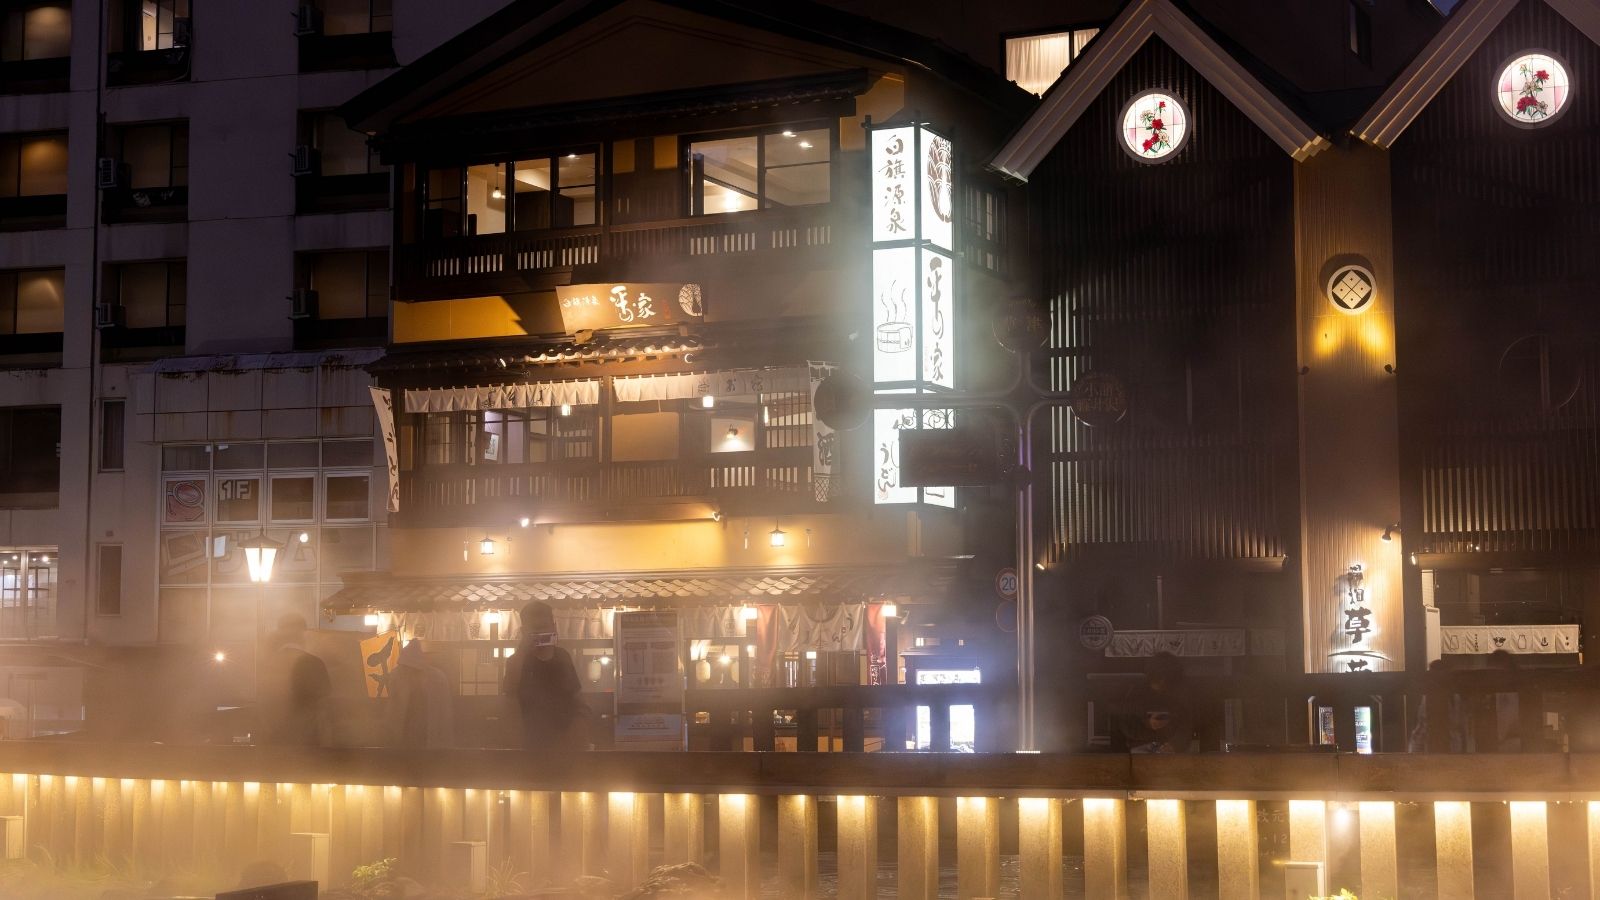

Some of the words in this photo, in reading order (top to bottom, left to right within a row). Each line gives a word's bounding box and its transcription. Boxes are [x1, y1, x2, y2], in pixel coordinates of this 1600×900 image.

[878, 134, 907, 234] 白旗源泉
[877, 443, 897, 493] うどん
[1001, 576, 1017, 591] 20
